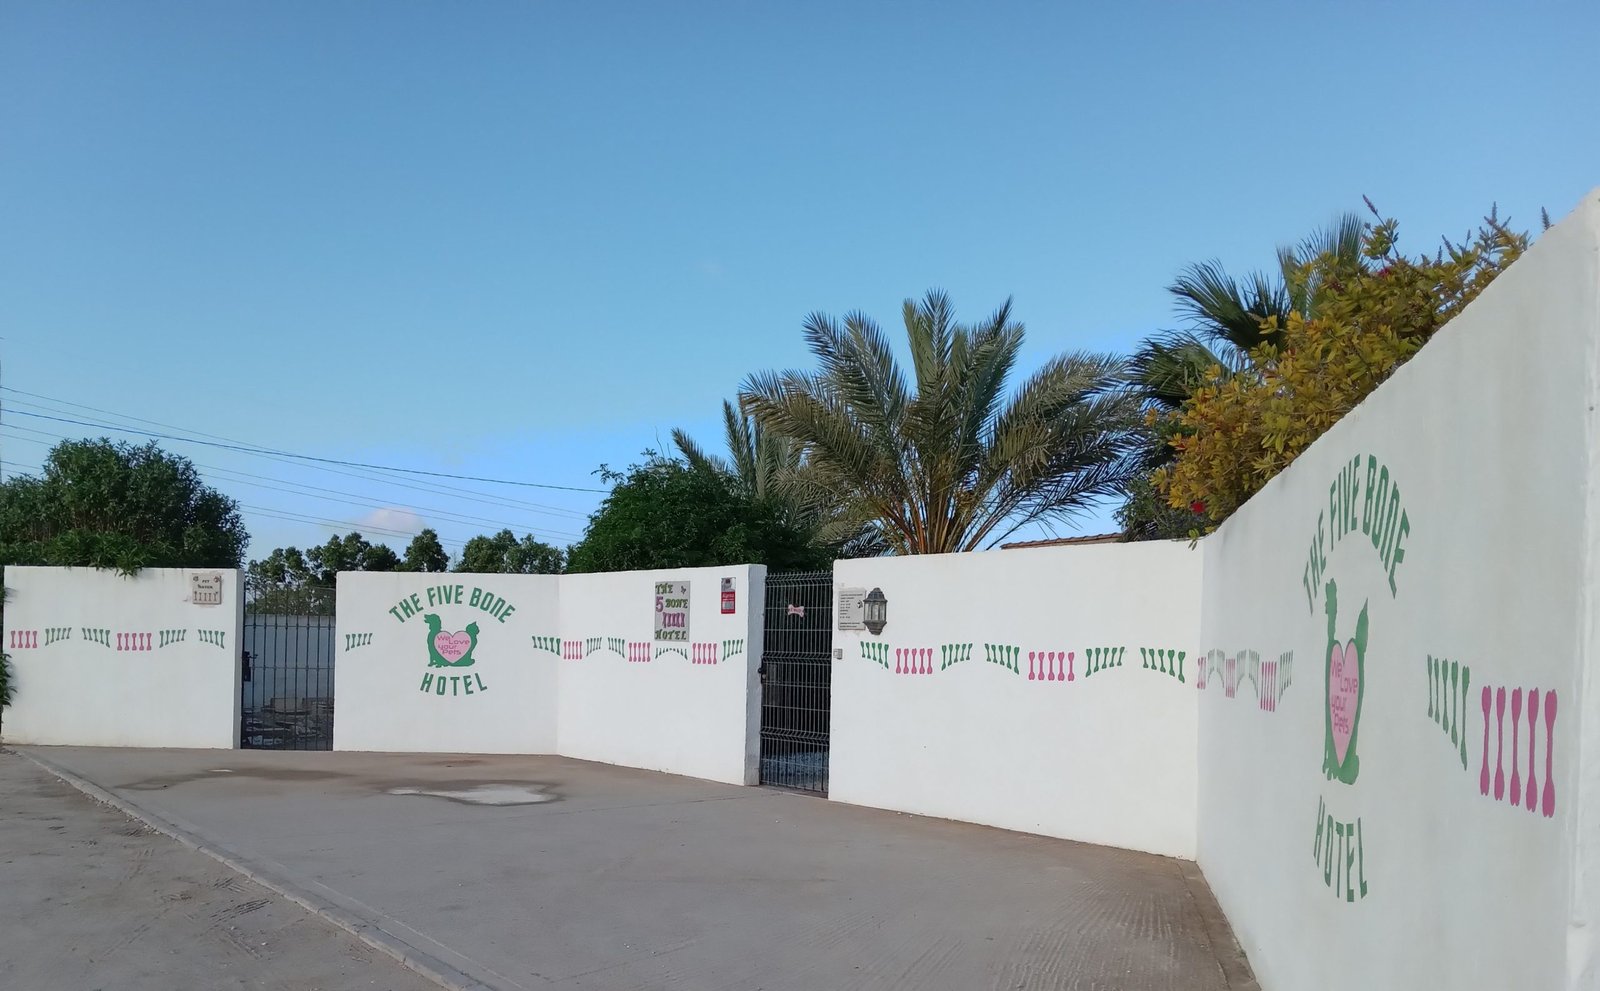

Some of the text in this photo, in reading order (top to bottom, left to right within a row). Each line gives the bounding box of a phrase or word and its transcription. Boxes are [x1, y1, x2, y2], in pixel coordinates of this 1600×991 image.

[1303, 453, 1411, 618] THE FIVE BONE
[655, 582, 674, 595] THE
[389, 585, 516, 623] THE FIVE BONE
[655, 595, 688, 613] 5 BONE
[654, 628, 687, 640] HOTEL
[420, 672, 488, 696] HOTEL
[1340, 677, 1358, 694] Love
[1333, 713, 1349, 735] Pets
[1313, 794, 1367, 903] HOTEL
